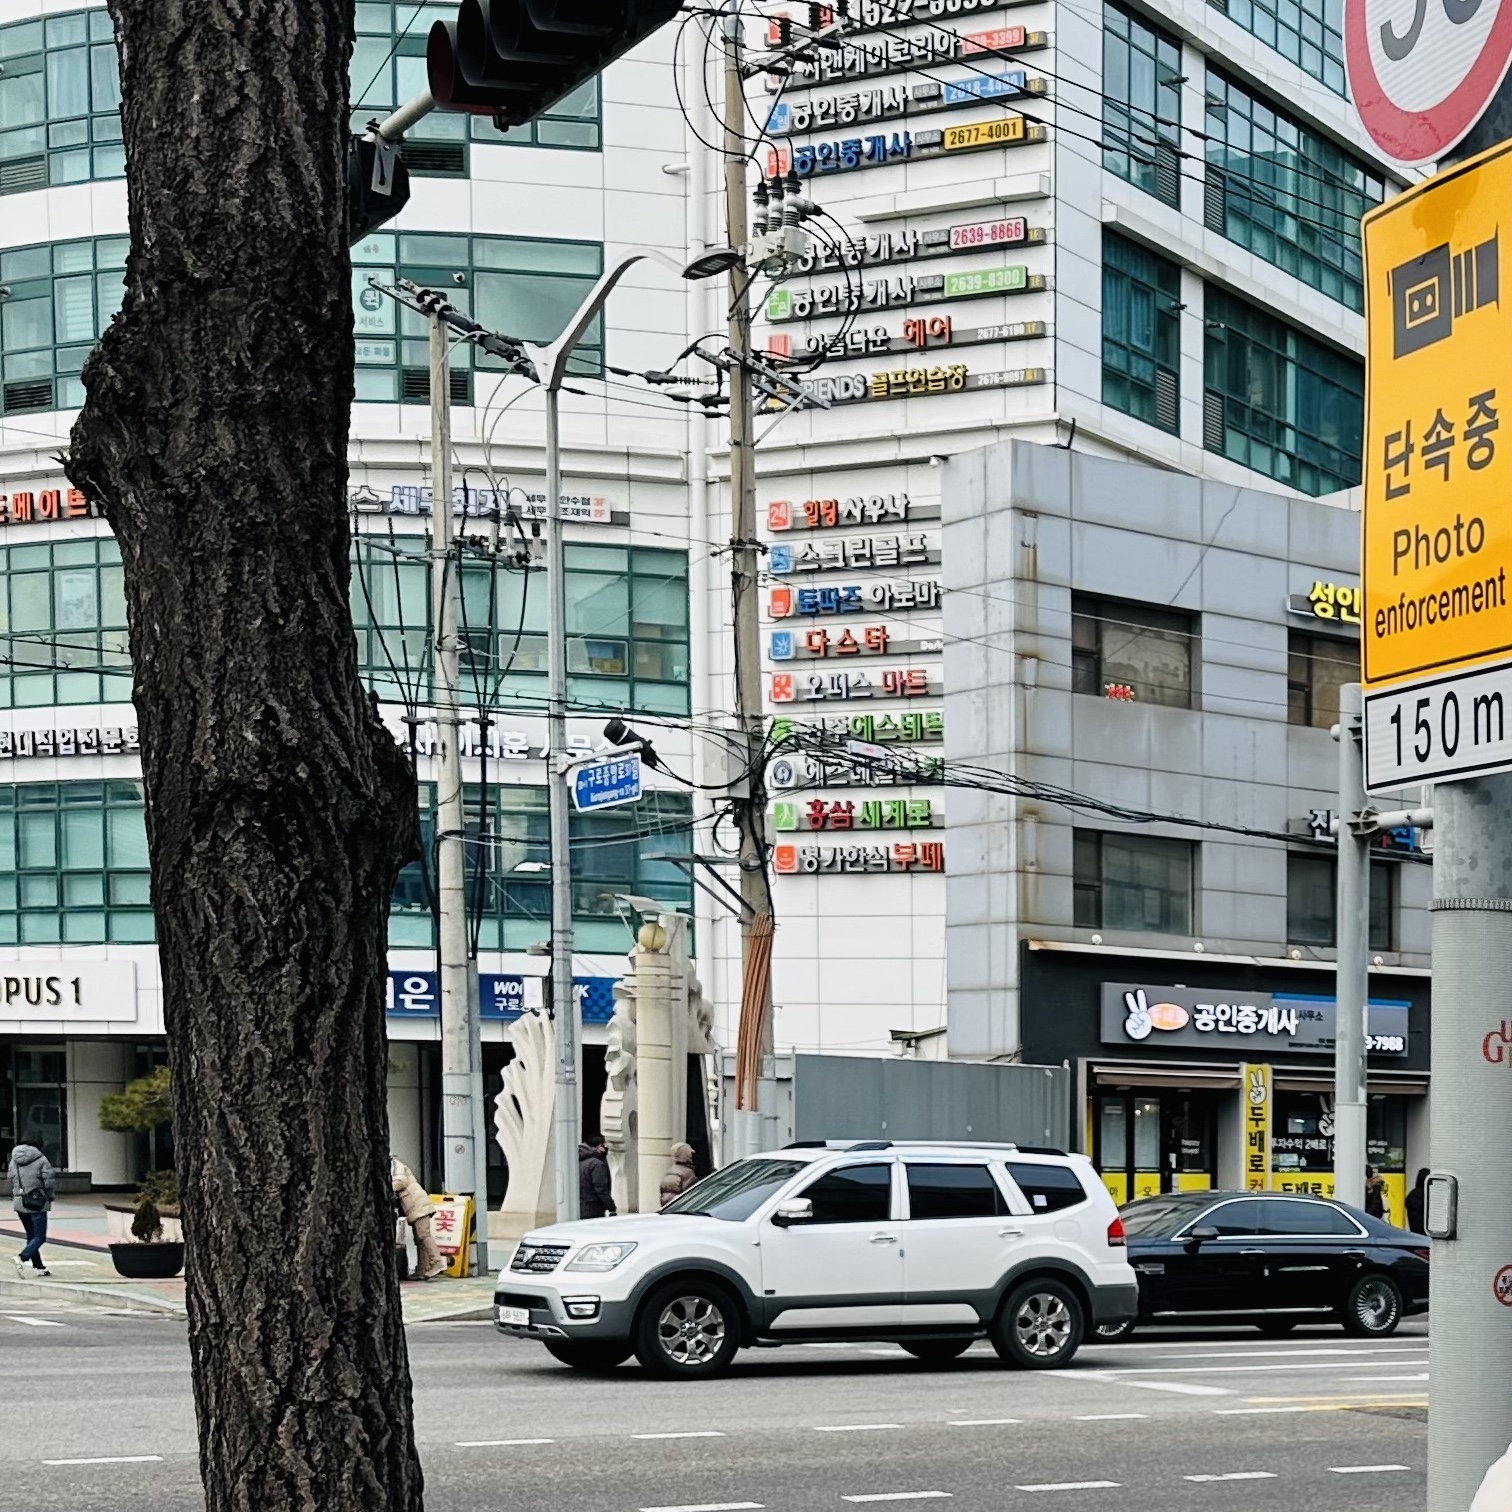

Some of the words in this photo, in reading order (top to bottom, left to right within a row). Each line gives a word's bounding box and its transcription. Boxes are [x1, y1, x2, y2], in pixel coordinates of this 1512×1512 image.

[791, 86, 908, 128] 공인중개사
[795, 131, 911, 174] 공인중개사
[950, 122, 1017, 145] 2677-4001
[954, 222, 1021, 246] 2639-8866
[793, 276, 914, 316] 공인중개사
[951, 269, 1020, 292] 2639-8300
[903, 316, 951, 347] 헤어
[870, 364, 968, 397] 골프연습장
[1383, 388, 1499, 501] 단속중
[769, 503, 788, 526] 24
[843, 494, 910, 523] 사우나
[796, 534, 927, 570] 스크린골프
[1393, 513, 1485, 577] Photo
[798, 585, 863, 614] 토파즈
[870, 581, 943, 610] 아로마
[1375, 566, 1506, 639] enforcement
[804, 671, 873, 699] 오피스
[882, 670, 928, 697] 마트
[1390, 691, 1460, 766] 150
[1473, 691, 1504, 746] m
[806, 799, 855, 829] 홍삼
[860, 800, 932, 829] 세계로
[70, 976, 83, 1006] 1
[1193, 1003, 1299, 1036] 공인중개사
[1248, 1107, 1266, 1172] 두배로
[435, 1210, 456, 1232] 꽃
